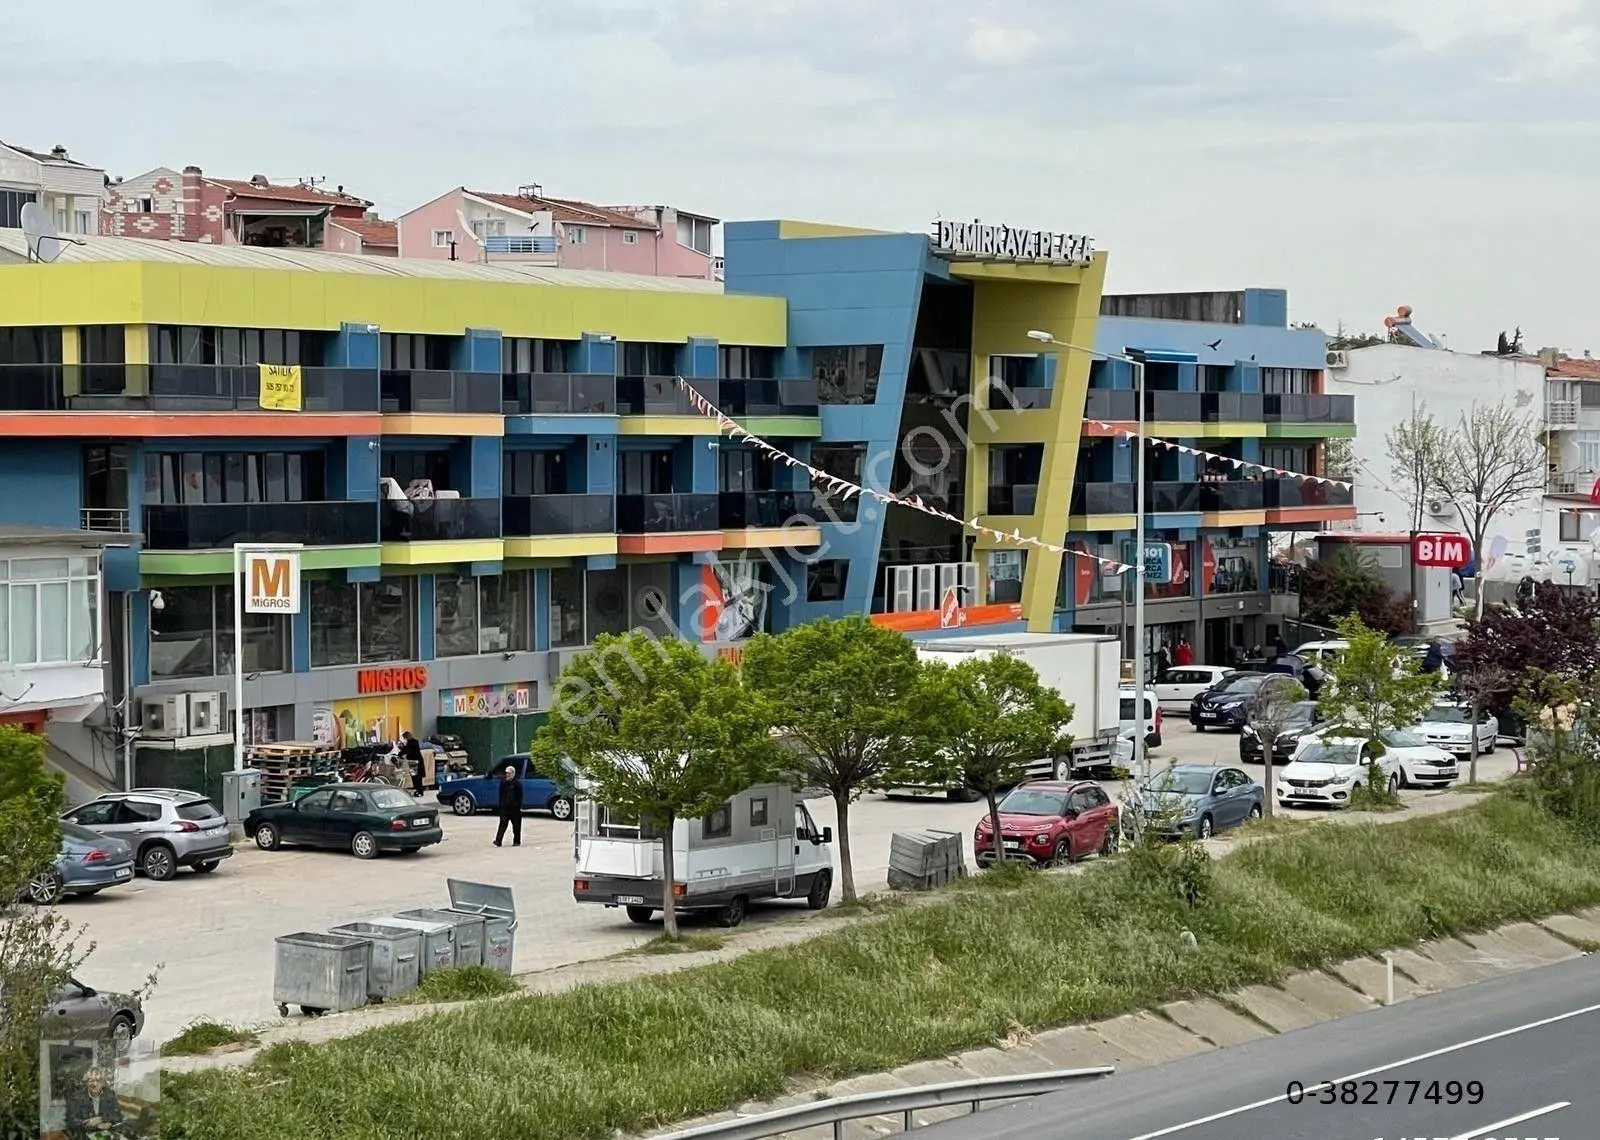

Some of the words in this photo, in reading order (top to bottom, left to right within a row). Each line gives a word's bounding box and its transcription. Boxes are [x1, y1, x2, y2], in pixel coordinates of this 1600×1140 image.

[939, 219, 1036, 259] DEMİRKAYA
[1418, 536, 1463, 562] BİM
[252, 559, 290, 597] M
